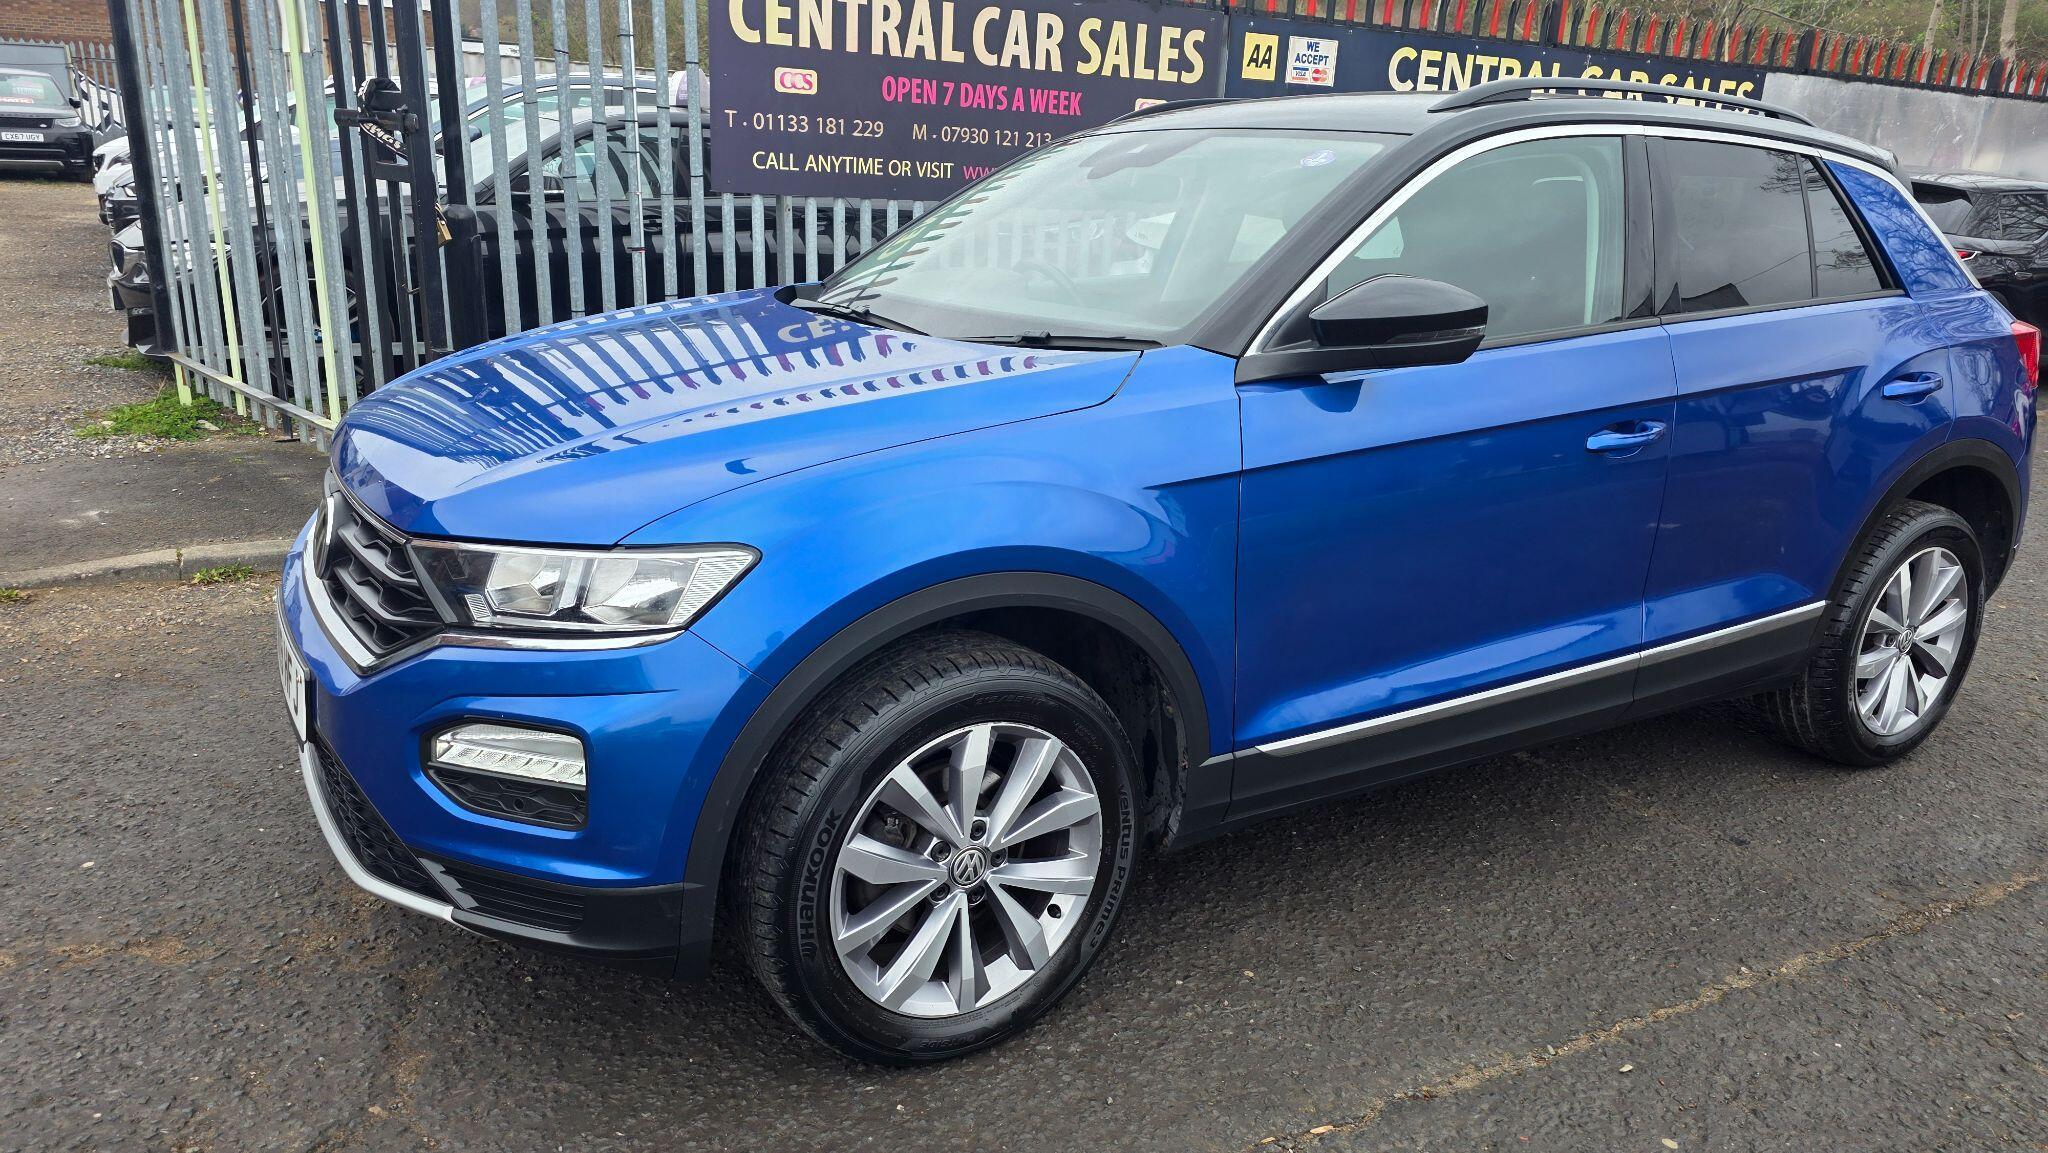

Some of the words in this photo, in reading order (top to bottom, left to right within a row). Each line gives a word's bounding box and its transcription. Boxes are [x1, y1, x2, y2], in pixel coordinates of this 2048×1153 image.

[728, 0, 964, 63] CENTRAL
[972, 6, 1063, 72] CAR
[1076, 17, 1206, 84] SALES
[1306, 41, 1320, 52] WE
[1246, 43, 1273, 69] AA
[1294, 53, 1329, 65] ACCEPT
[780, 71, 813, 91] CCS
[882, 75, 937, 105] OPEN
[942, 82, 955, 106] 7
[960, 82, 1008, 111] DAYS
[1011, 87, 1025, 112] A
[1029, 88, 1082, 116] WEEK
[753, 112, 809, 133] 01133
[816, 117, 845, 135] 181
[852, 120, 884, 138] 229
[941, 126, 989, 145] 07930
[994, 129, 1019, 146] 121
[752, 151, 800, 171] CALL
[804, 154, 884, 176] ANYTIME
[888, 159, 912, 177] OR
[916, 161, 954, 179] VISIT
[963, 166, 1001, 180] WW
